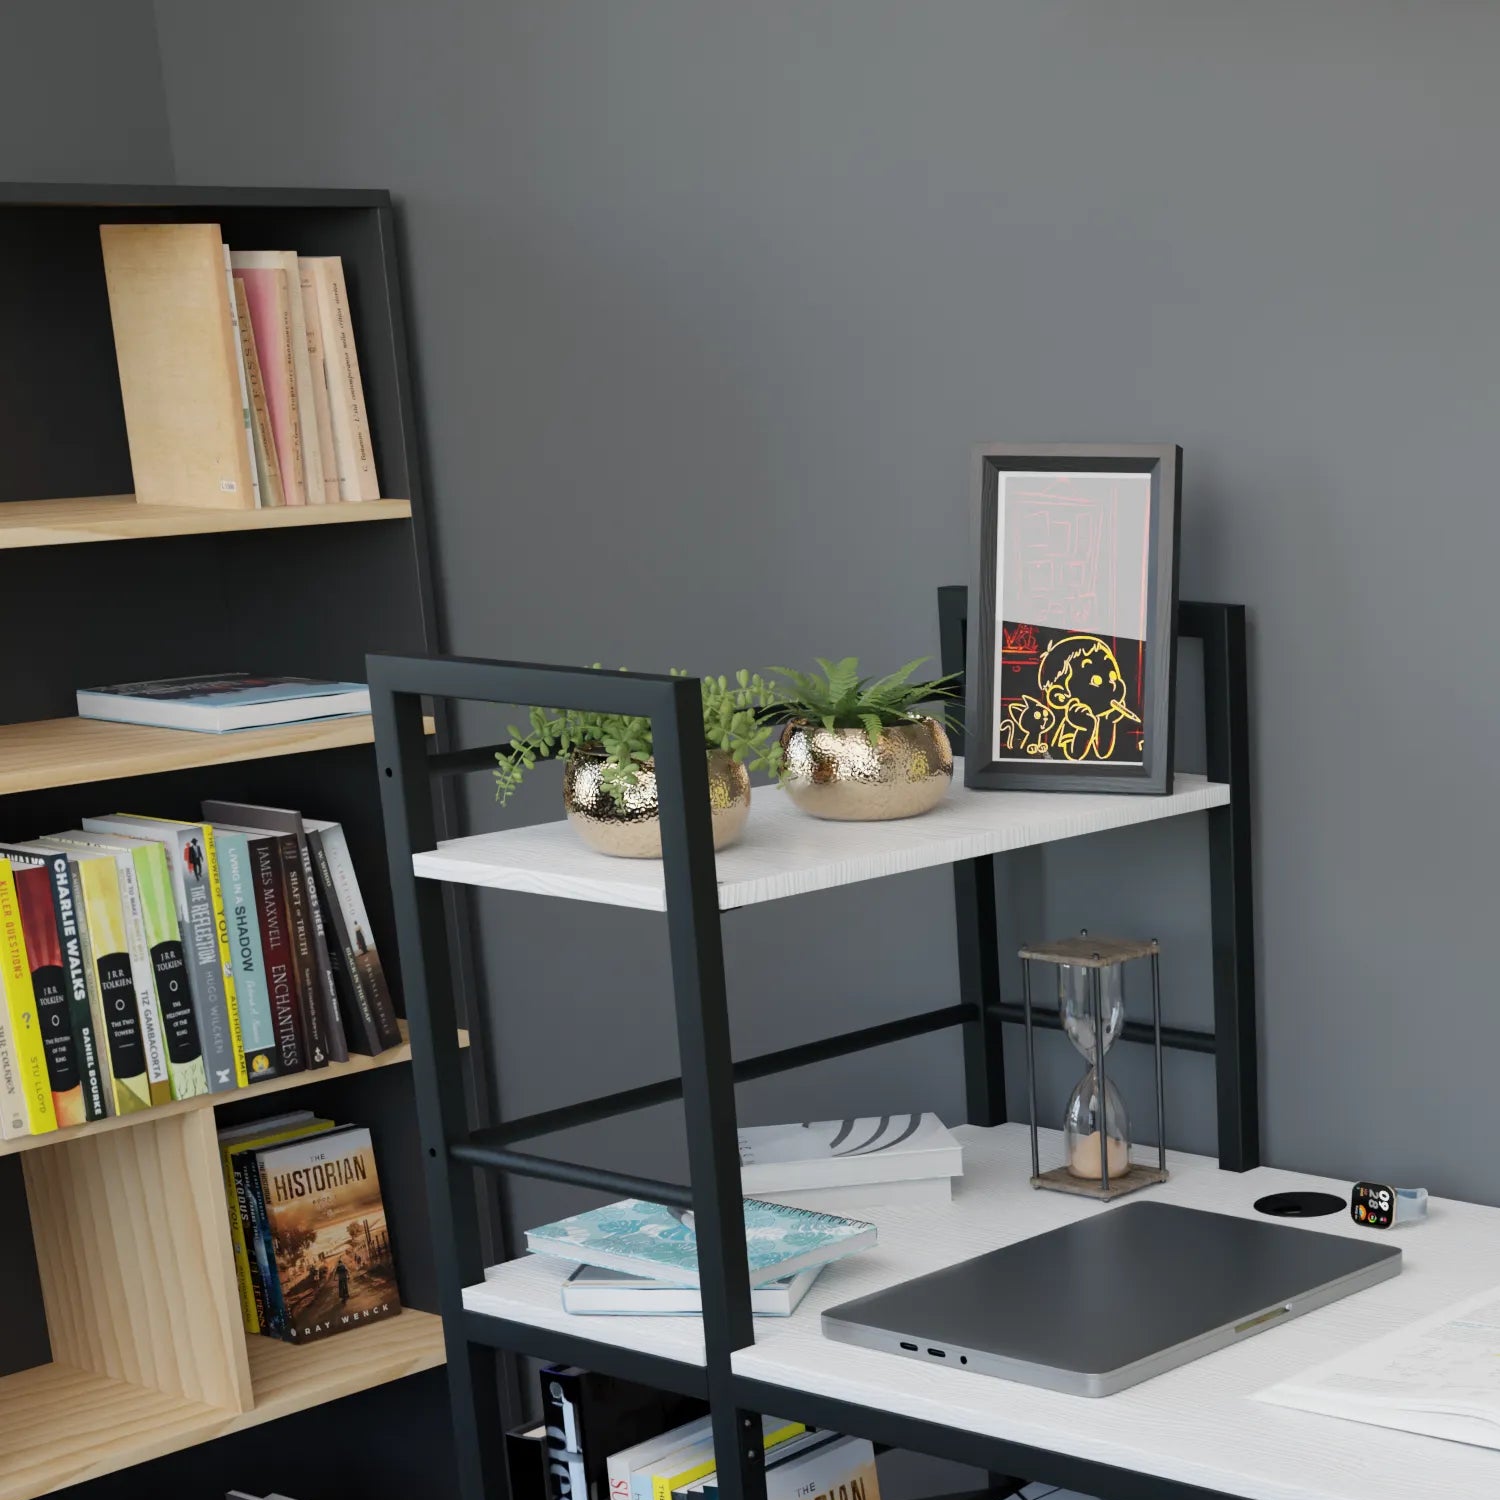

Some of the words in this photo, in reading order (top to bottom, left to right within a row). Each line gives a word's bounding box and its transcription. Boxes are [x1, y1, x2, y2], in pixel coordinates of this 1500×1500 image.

[190, 885, 206, 902] THE
[256, 846, 273, 885] JAMES
[301, 845, 312, 873] TITLE
[307, 876, 319, 907] GOES
[313, 909, 325, 936] HERE
[54, 858, 76, 937] CHARLIE
[67, 938, 86, 1001] WALKS
[192, 903, 216, 965] REFLECTION
[217, 908, 229, 943] YOU
[235, 906, 254, 972] SHADOW
[263, 888, 281, 951] MAXWELL
[289, 871, 301, 905] SHAFT
[297, 920, 308, 956] TRUTH
[102, 975, 132, 991] TOLKIEN
[156, 957, 182, 971] TOLKIEN
[143, 1007, 161, 1080] GAMBACORTA
[271, 966, 298, 1067] ENCHANTRESS
[82, 1027, 94, 1069] DANIEL
[88, 1069, 102, 1115] BOURKE
[274, 1154, 367, 1202] HISTORIAN
[304, 1322, 330, 1335] RAY
[341, 1304, 389, 1324] WENCK
[796, 1481, 816, 1498] THE
